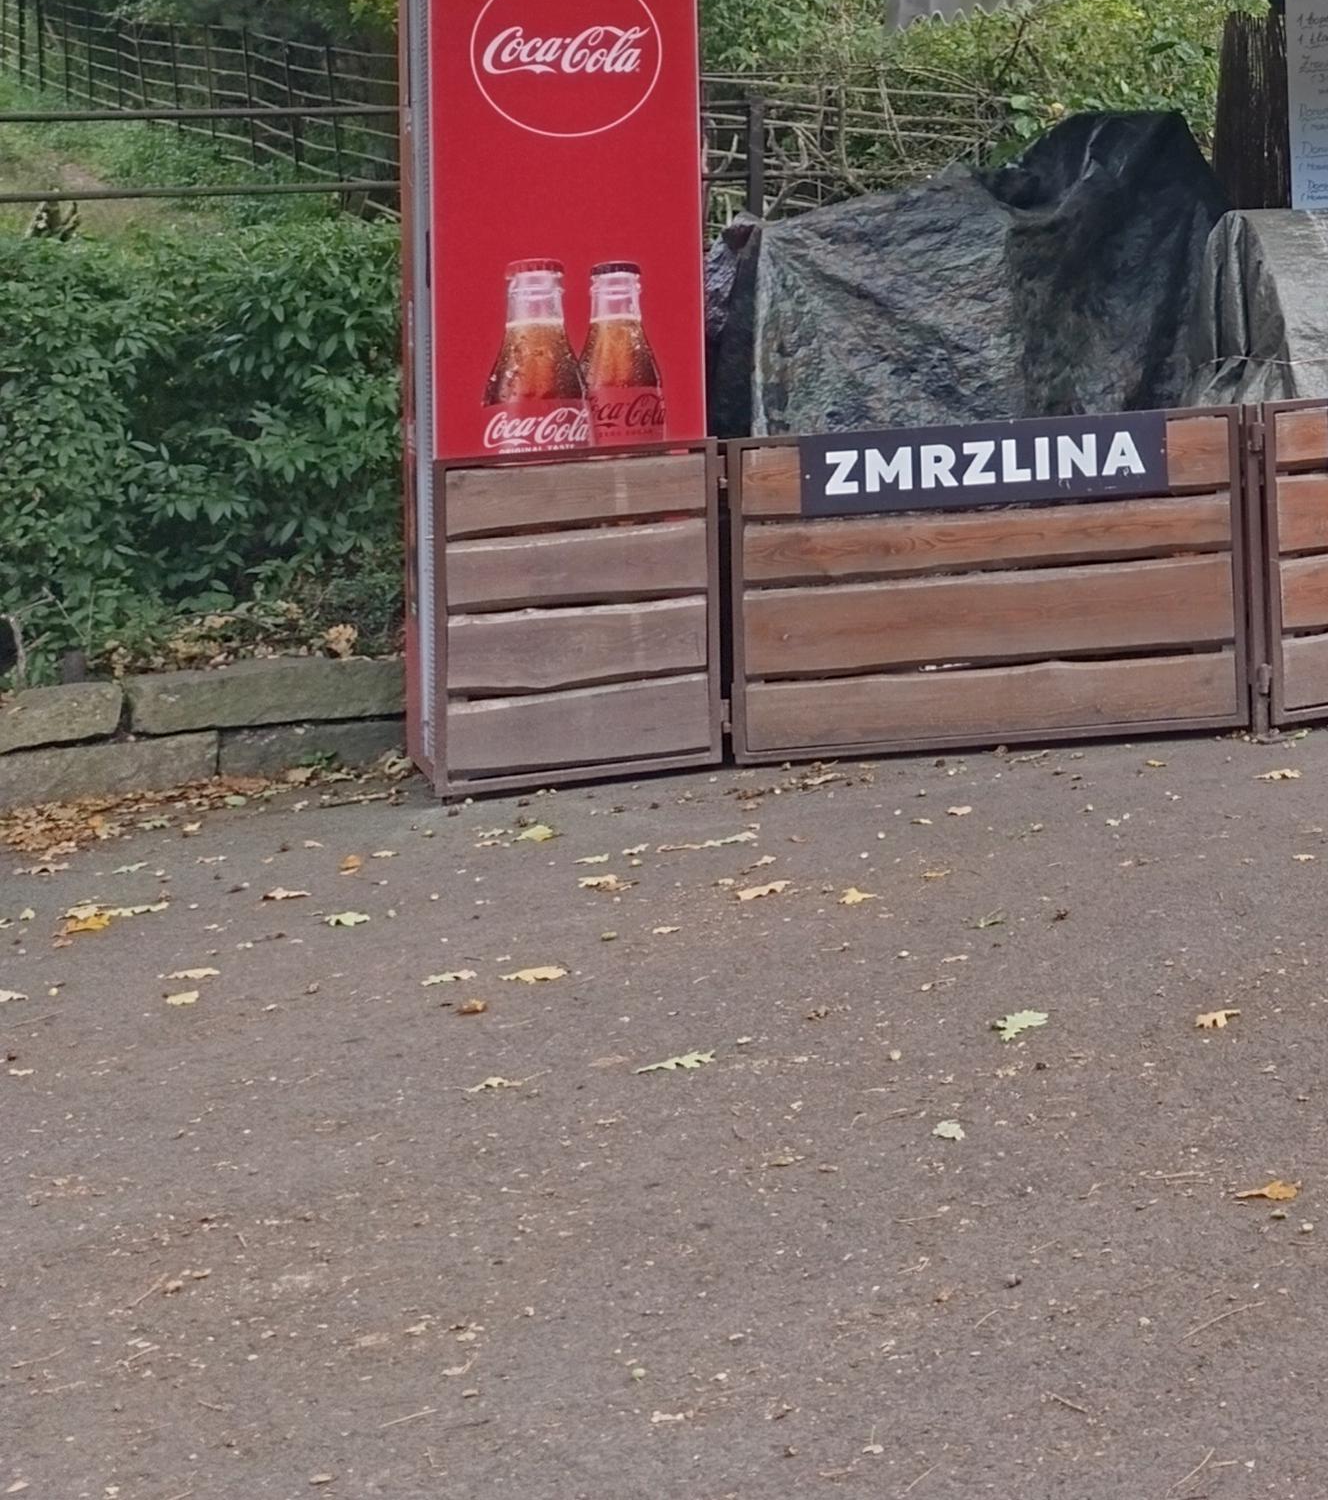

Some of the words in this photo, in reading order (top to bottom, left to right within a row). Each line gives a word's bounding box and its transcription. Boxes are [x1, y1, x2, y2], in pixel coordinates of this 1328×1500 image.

[482, 26, 651, 74] Coca-Cola
[484, 407, 589, 448] Coca-Cola
[825, 431, 1146, 496] ZMRZLINA
